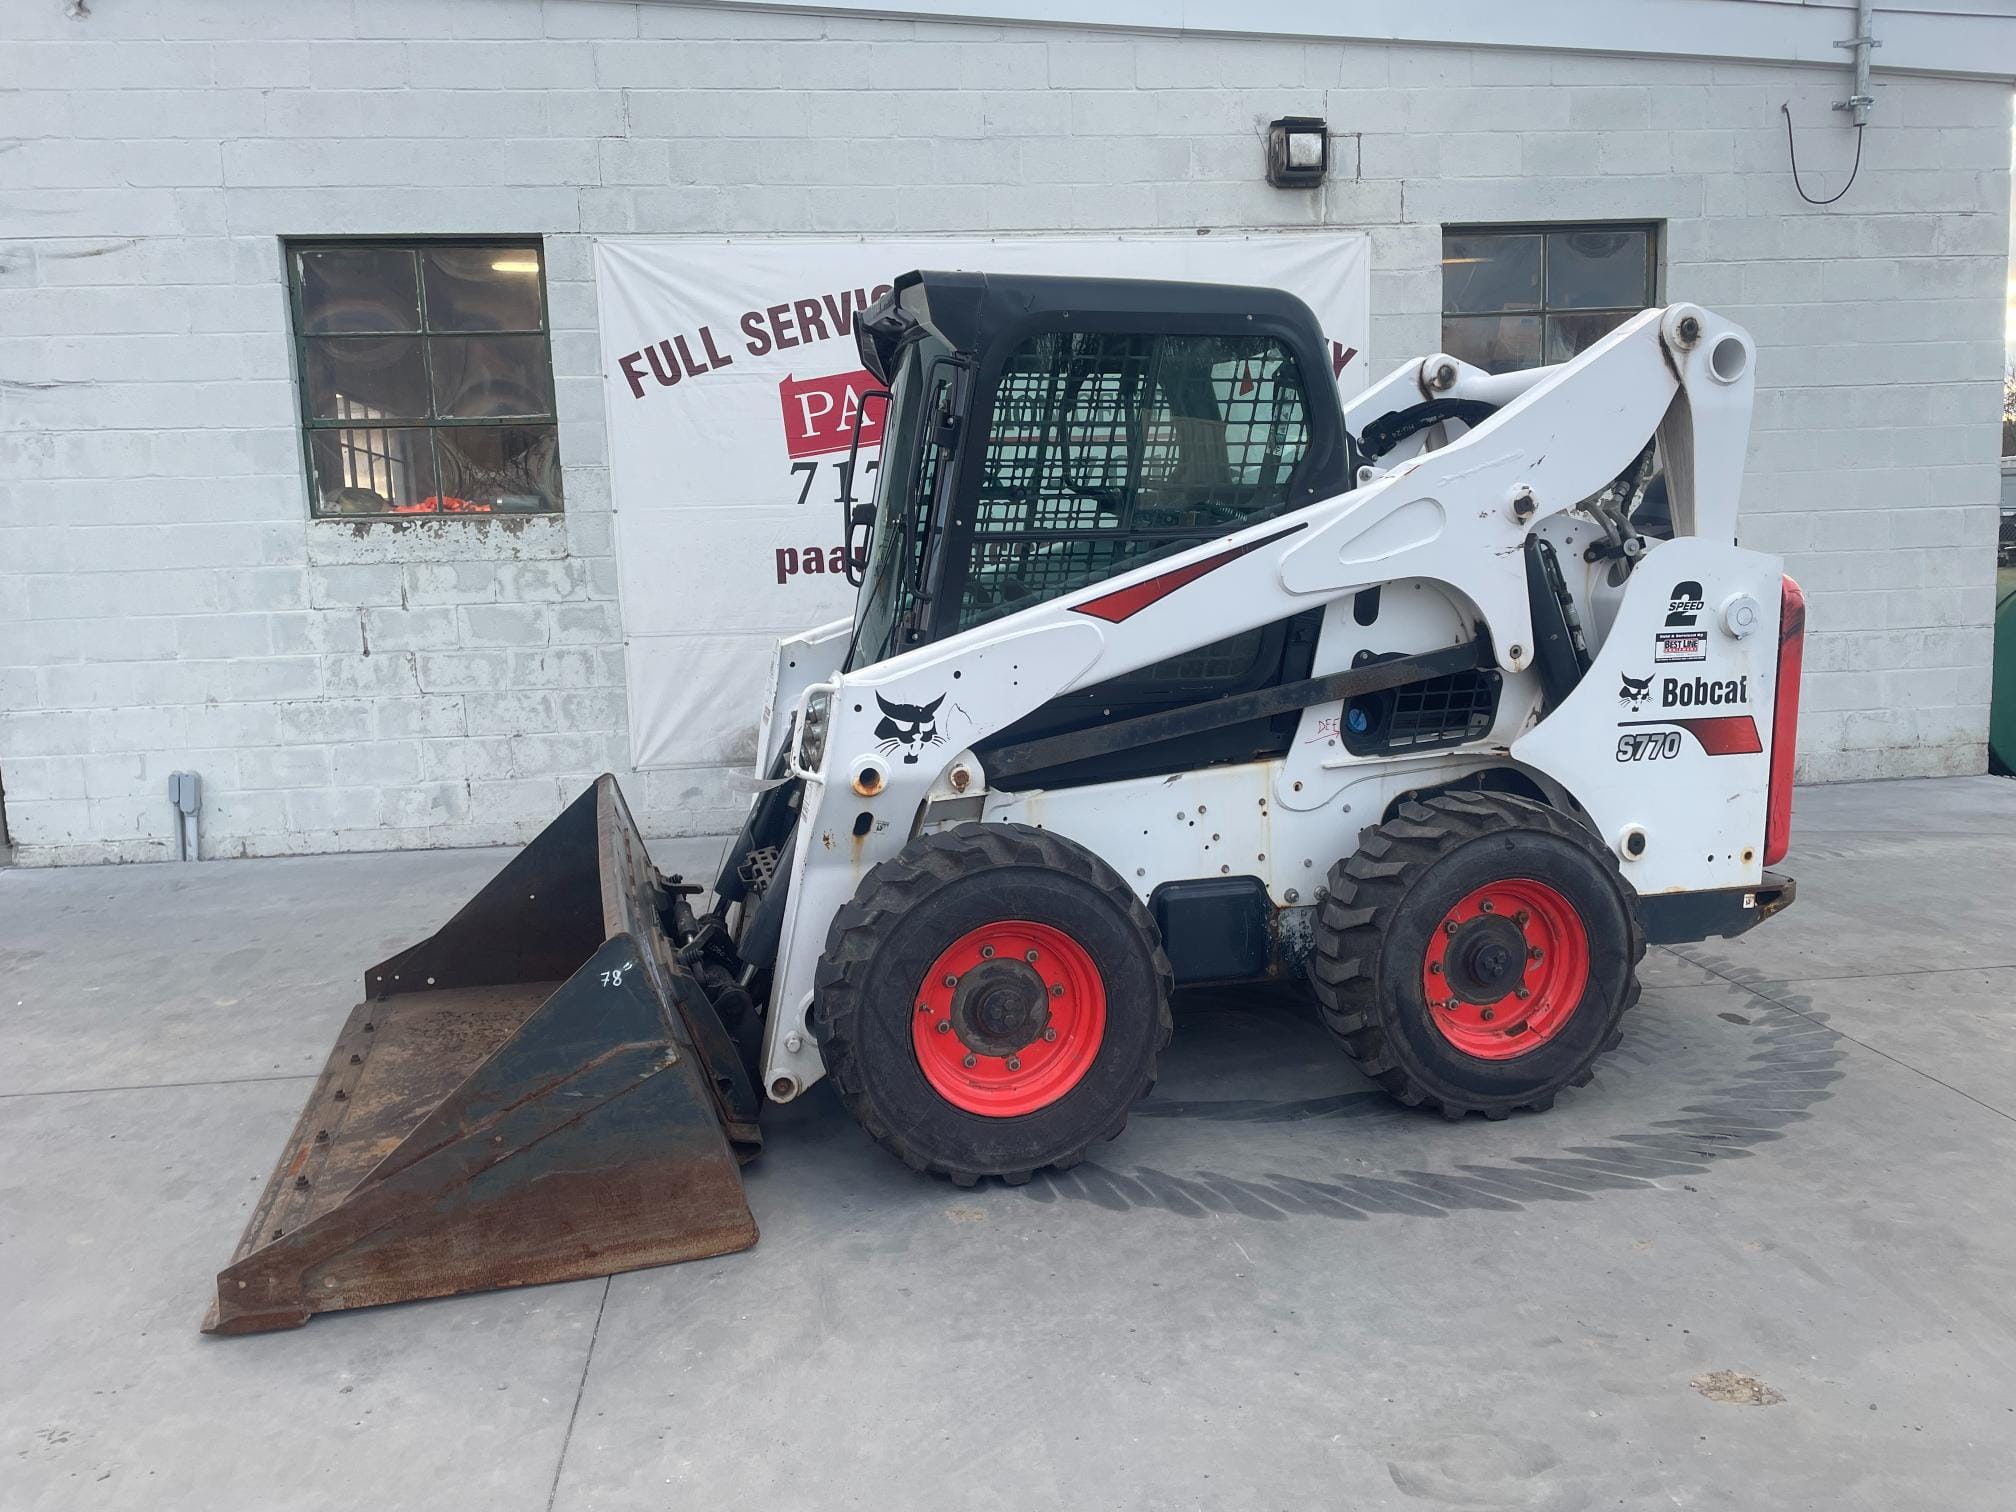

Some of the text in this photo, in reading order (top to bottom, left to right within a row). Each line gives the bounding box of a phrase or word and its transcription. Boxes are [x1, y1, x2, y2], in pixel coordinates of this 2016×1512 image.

[618, 326, 734, 400] FULL
[1665, 581, 1703, 627] 2
[1668, 601, 1704, 612] SPEED
[1665, 639, 1699, 649] BEST LINE
[1662, 675, 1747, 708] Bobcat
[1616, 731, 1682, 762] S770
